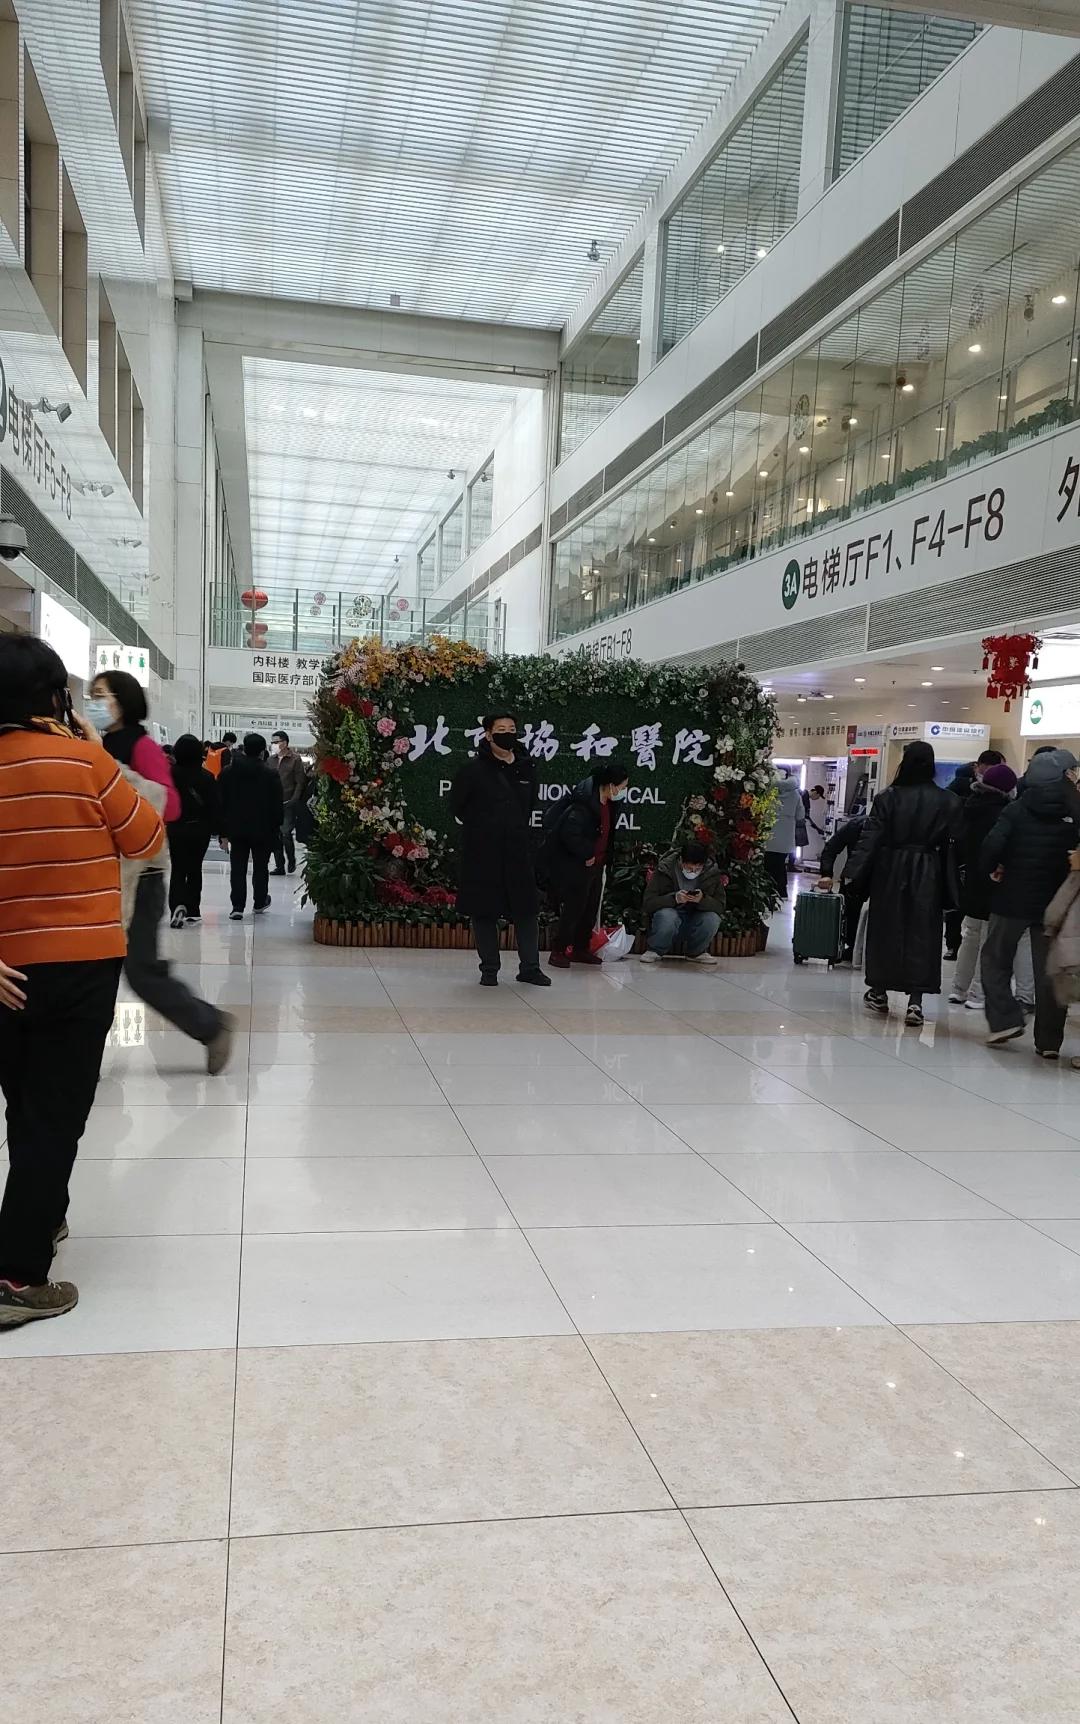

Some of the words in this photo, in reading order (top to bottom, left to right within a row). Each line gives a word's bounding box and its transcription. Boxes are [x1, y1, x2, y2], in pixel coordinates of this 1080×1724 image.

[784, 572, 797, 597] 3A
[253, 656, 290, 669] 内科楼
[296, 658, 327, 670] 教学
